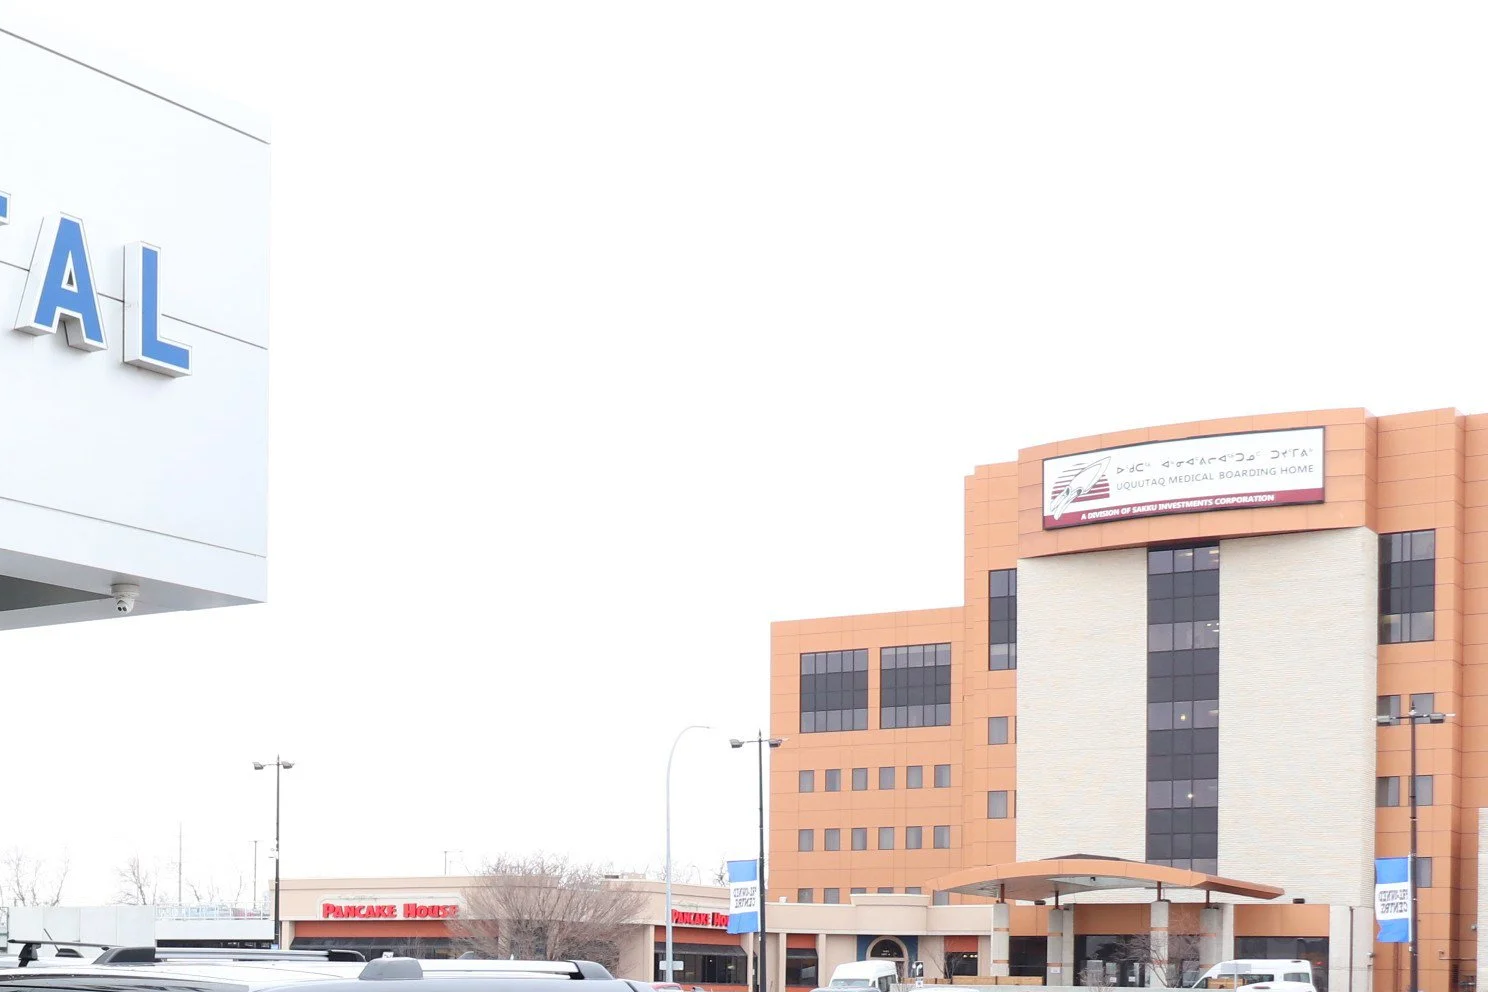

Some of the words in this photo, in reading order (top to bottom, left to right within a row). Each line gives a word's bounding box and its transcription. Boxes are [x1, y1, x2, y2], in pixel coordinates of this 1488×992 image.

[1116, 477, 1167, 491] UQUUTAQ
[1168, 472, 1215, 485] MEDICAL
[1218, 467, 1277, 480] BOARDING
[1280, 464, 1314, 475] HOME
[1080, 513, 1088, 521] A
[1088, 509, 1120, 520] DIVISION
[1121, 507, 1132, 515] OF
[1132, 505, 1157, 514] SAKKU
[1158, 499, 1214, 511] INVESTMENTS
[1214, 494, 1275, 506] CORPORATION
[322, 903, 397, 919] PANCAKE
[403, 903, 459, 918] HOUSE
[671, 908, 711, 926] PANCAKE
